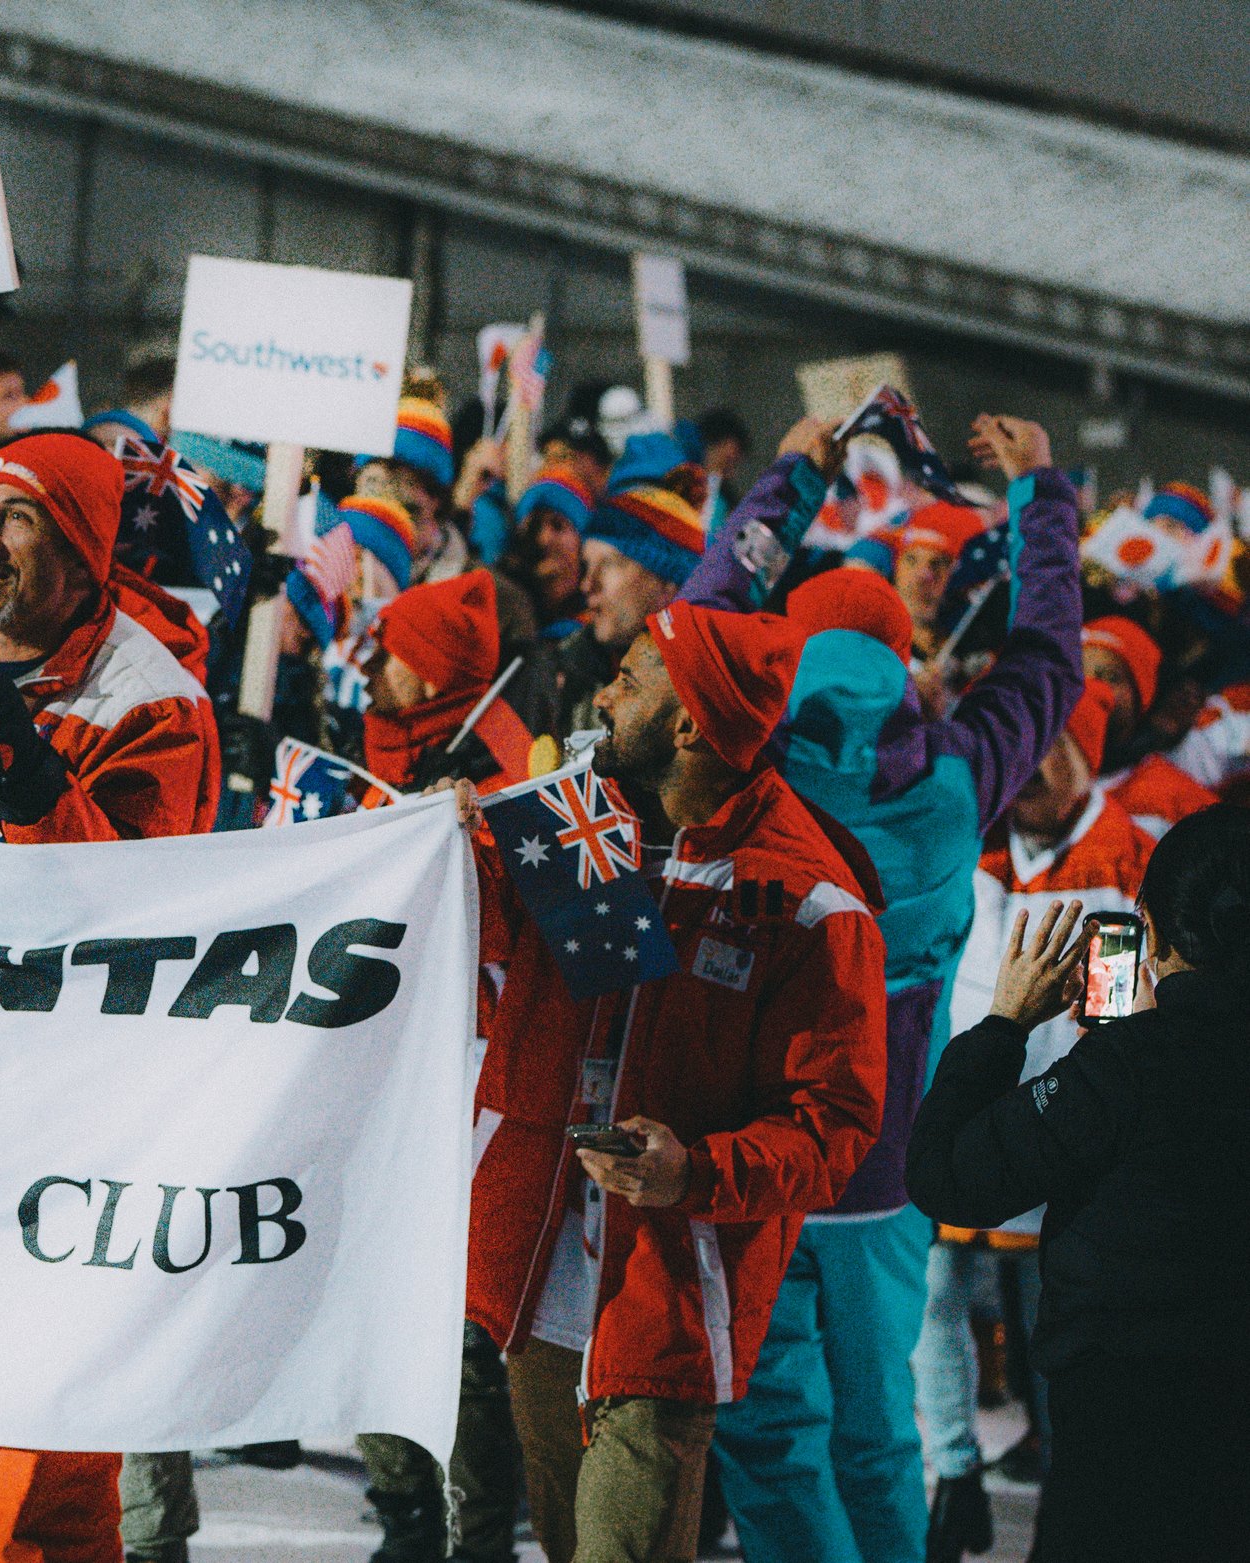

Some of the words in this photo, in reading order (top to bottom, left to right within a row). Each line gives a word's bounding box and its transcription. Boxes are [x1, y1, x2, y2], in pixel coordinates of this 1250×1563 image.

[191, 329, 363, 381] Southwest
[1036, 1079, 1049, 1107] Hilton
[17, 1175, 307, 1274] CLUB
